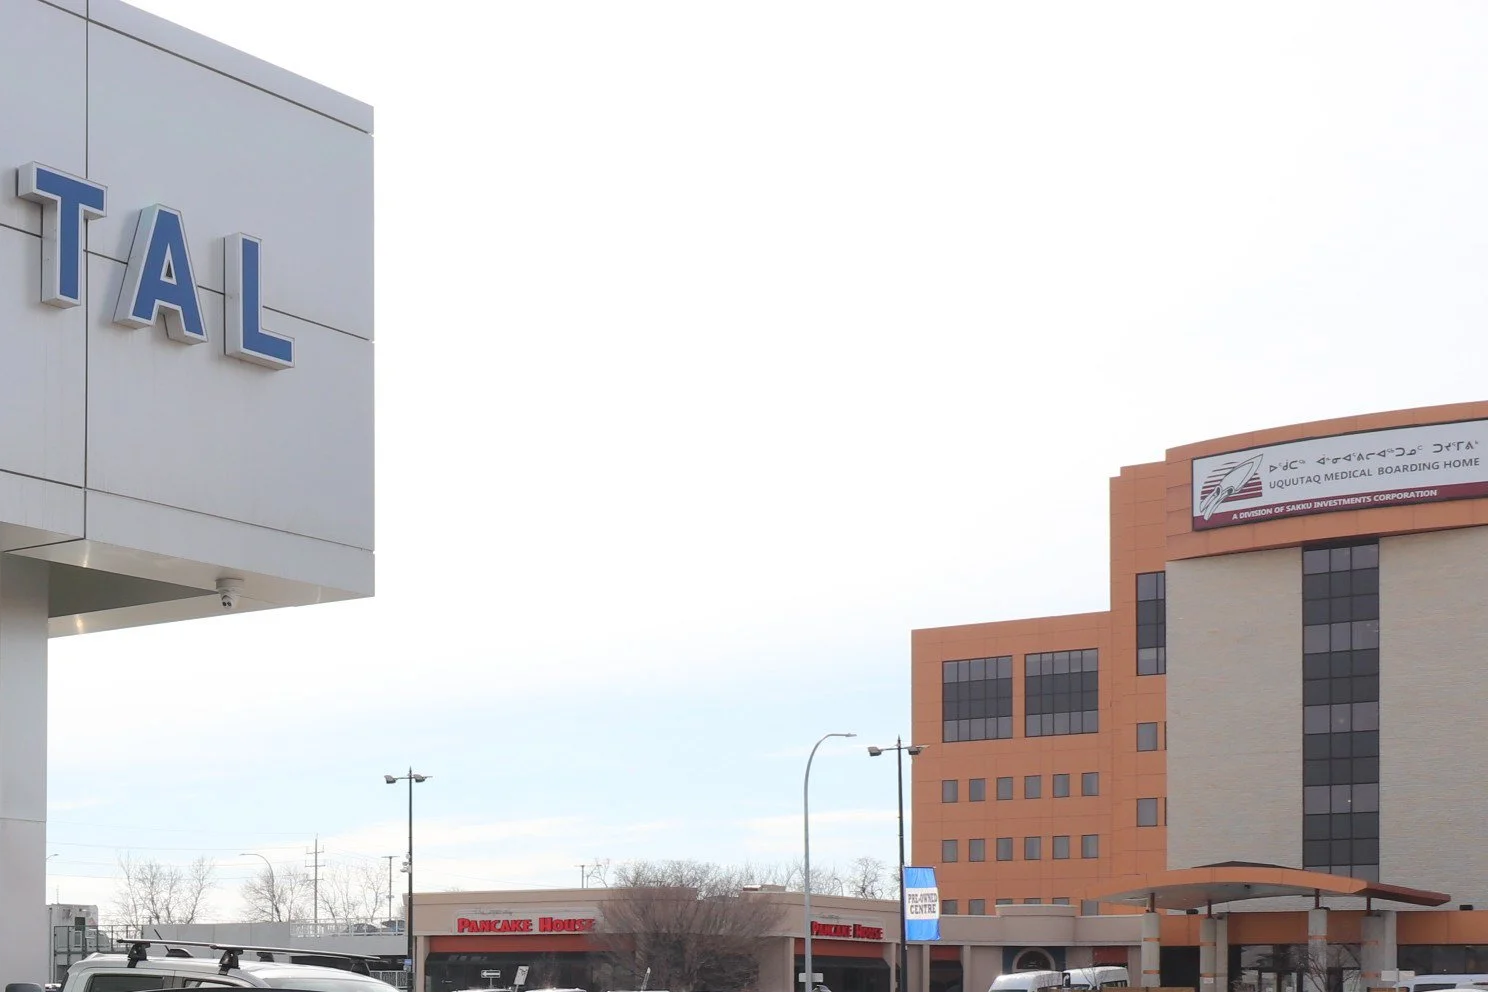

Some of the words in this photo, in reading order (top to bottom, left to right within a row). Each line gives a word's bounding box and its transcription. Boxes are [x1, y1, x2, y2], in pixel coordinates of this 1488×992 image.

[1269, 474, 1322, 489] UQUUTAQ
[1324, 468, 1373, 482] MEDICAL
[1377, 461, 1440, 476] BOARDING
[1443, 457, 1480, 469] HOME
[1232, 513, 1239, 521] A
[1239, 507, 1273, 519] DIVISION
[1274, 506, 1285, 514] OF
[1286, 503, 1312, 512] SAKKU
[1313, 496, 1372, 509] INVESTMENTS
[1373, 489, 1438, 502] CORPORATION
[907, 892, 938, 904] PRE-OWNED
[909, 904, 937, 915] CENTRE
